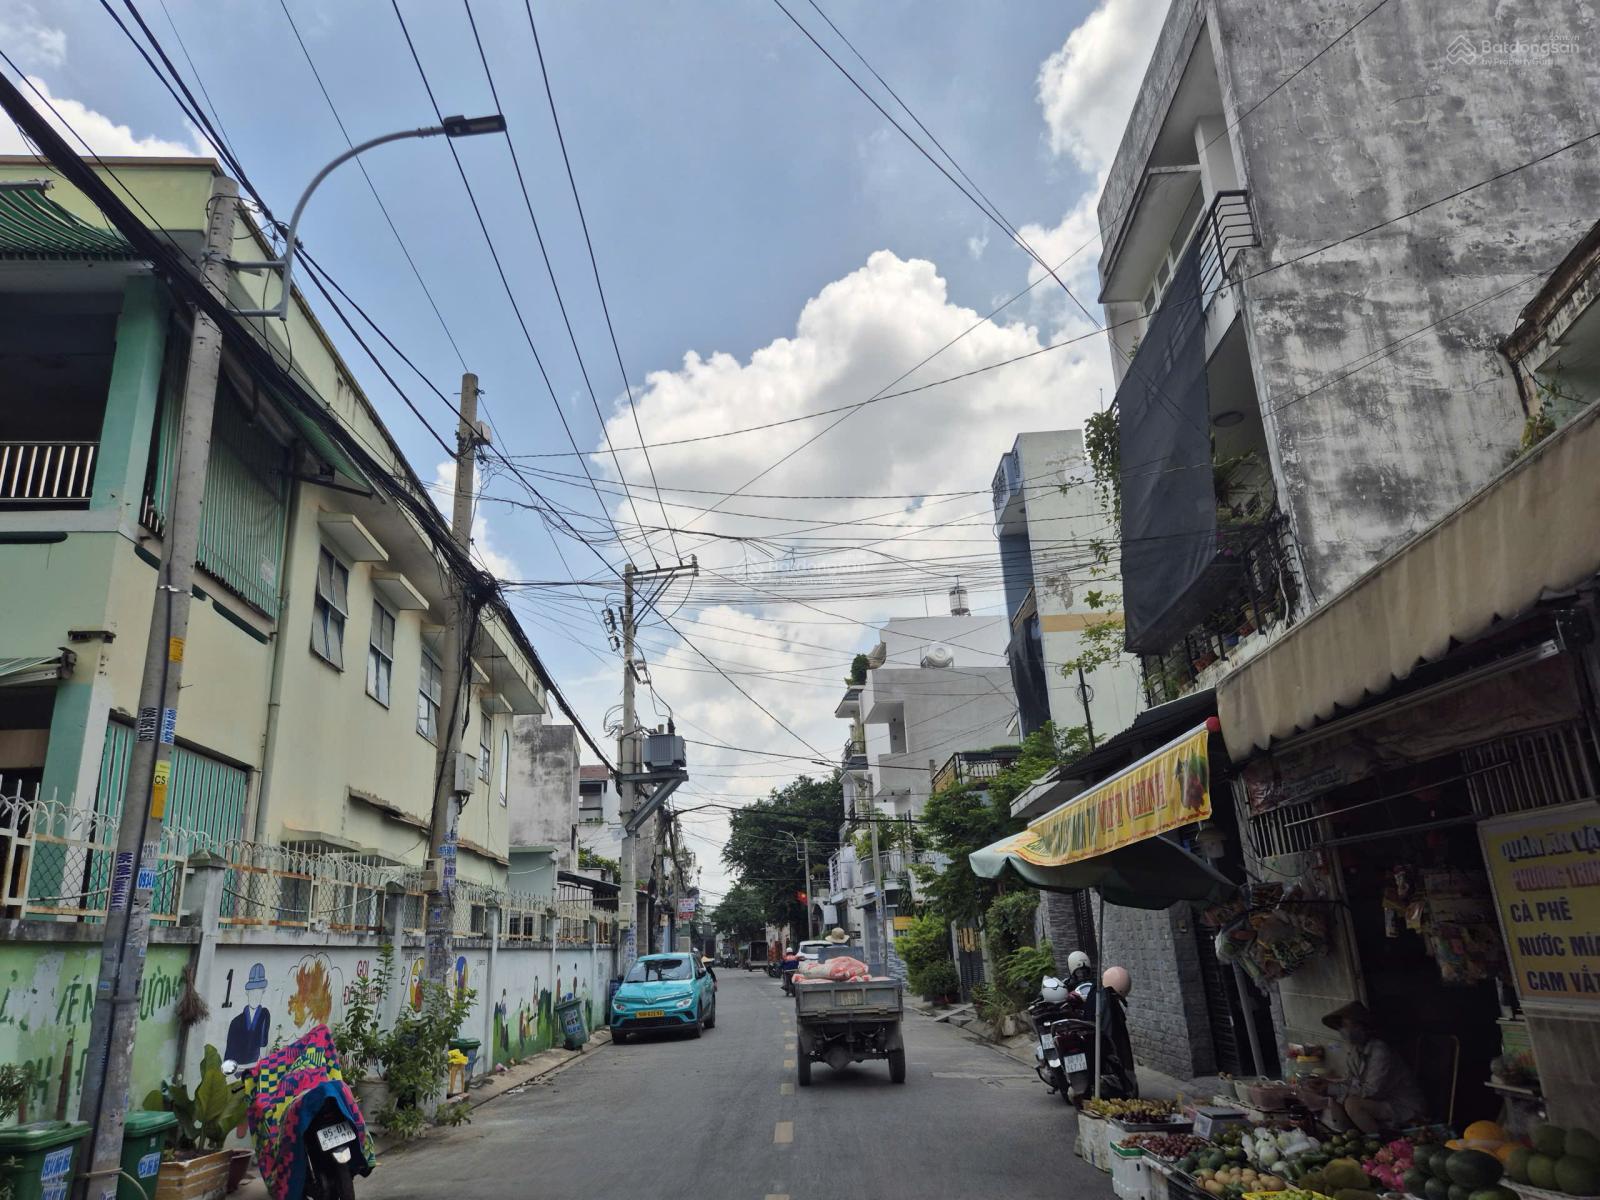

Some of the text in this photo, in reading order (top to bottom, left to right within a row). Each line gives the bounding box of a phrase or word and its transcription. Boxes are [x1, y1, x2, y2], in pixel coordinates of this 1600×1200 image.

[1509, 896, 1573, 923] CÀ PHÊ
[1517, 931, 1566, 957] NƯỚC
[221, 968, 234, 1009] 1
[1526, 970, 1568, 992] CAM
